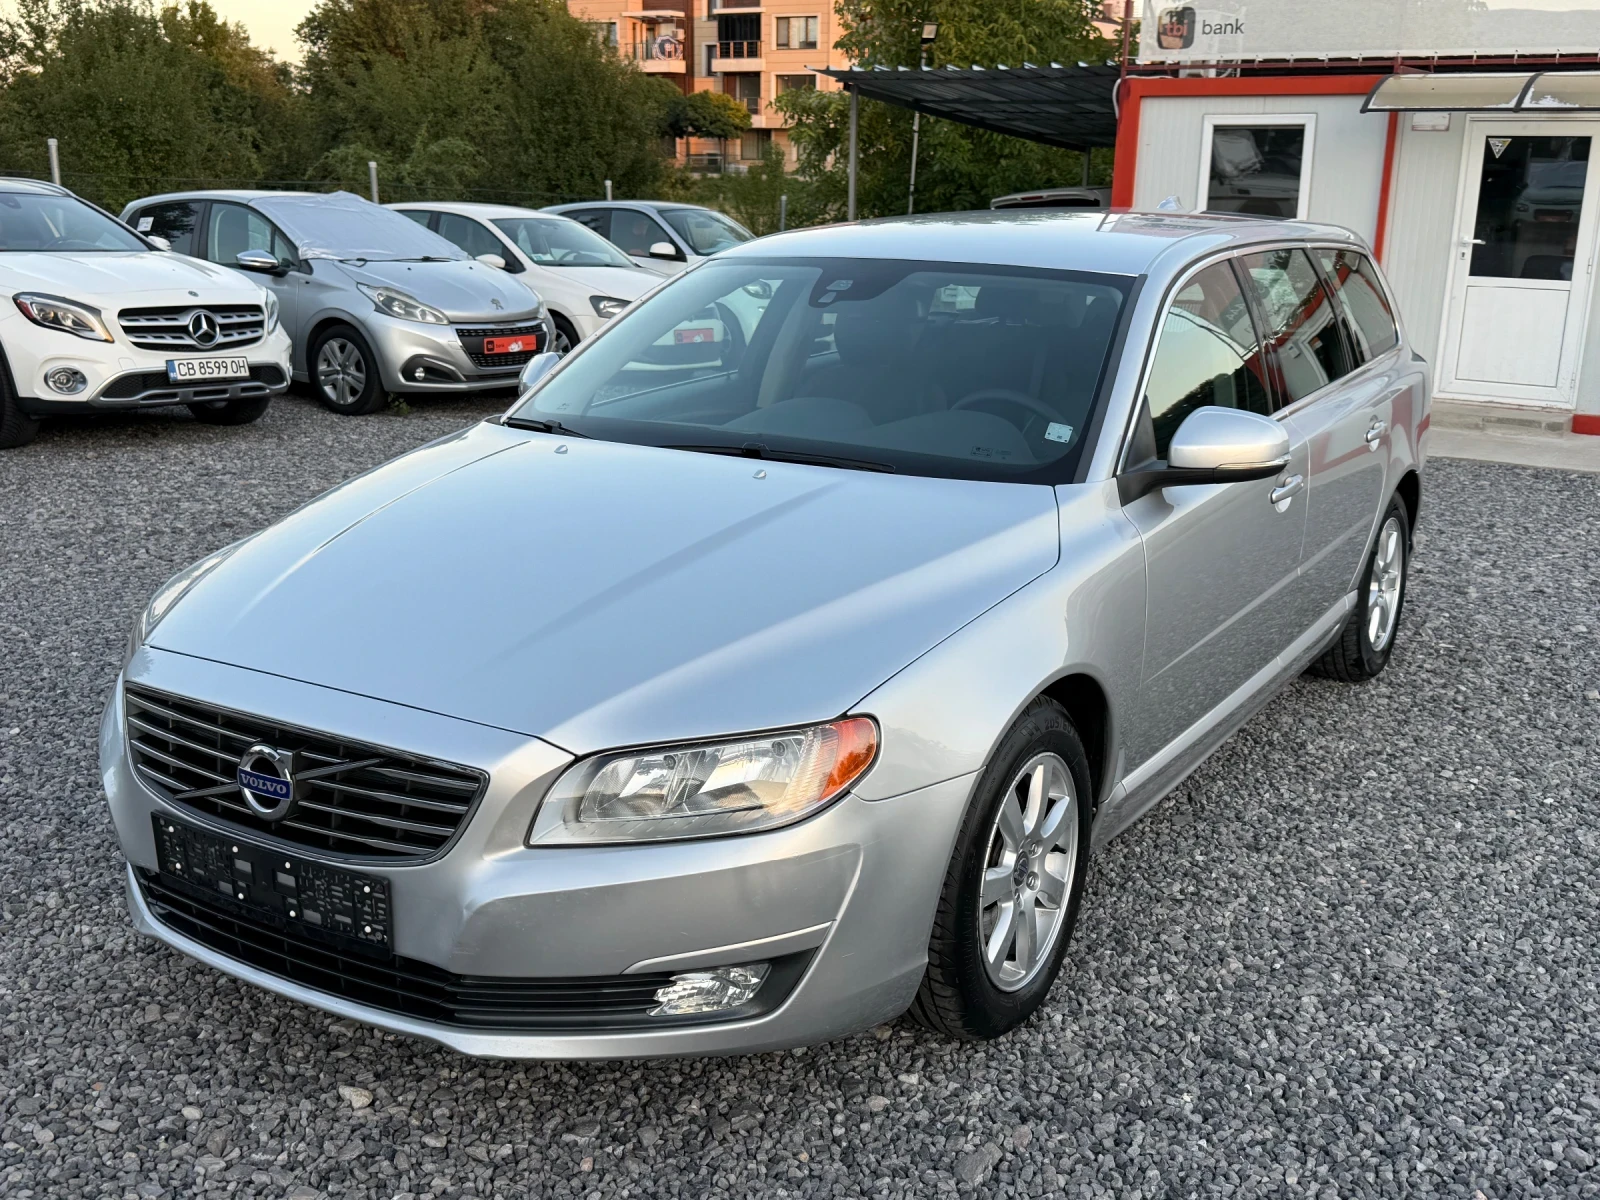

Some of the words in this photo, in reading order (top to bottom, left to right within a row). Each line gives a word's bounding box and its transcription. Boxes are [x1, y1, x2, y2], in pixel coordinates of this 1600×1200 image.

[1165, 19, 1189, 36] tbi
[1201, 18, 1245, 35] bank
[177, 361, 196, 377] CB
[198, 360, 228, 376] 8599
[240, 773, 287, 794] VOLVO
